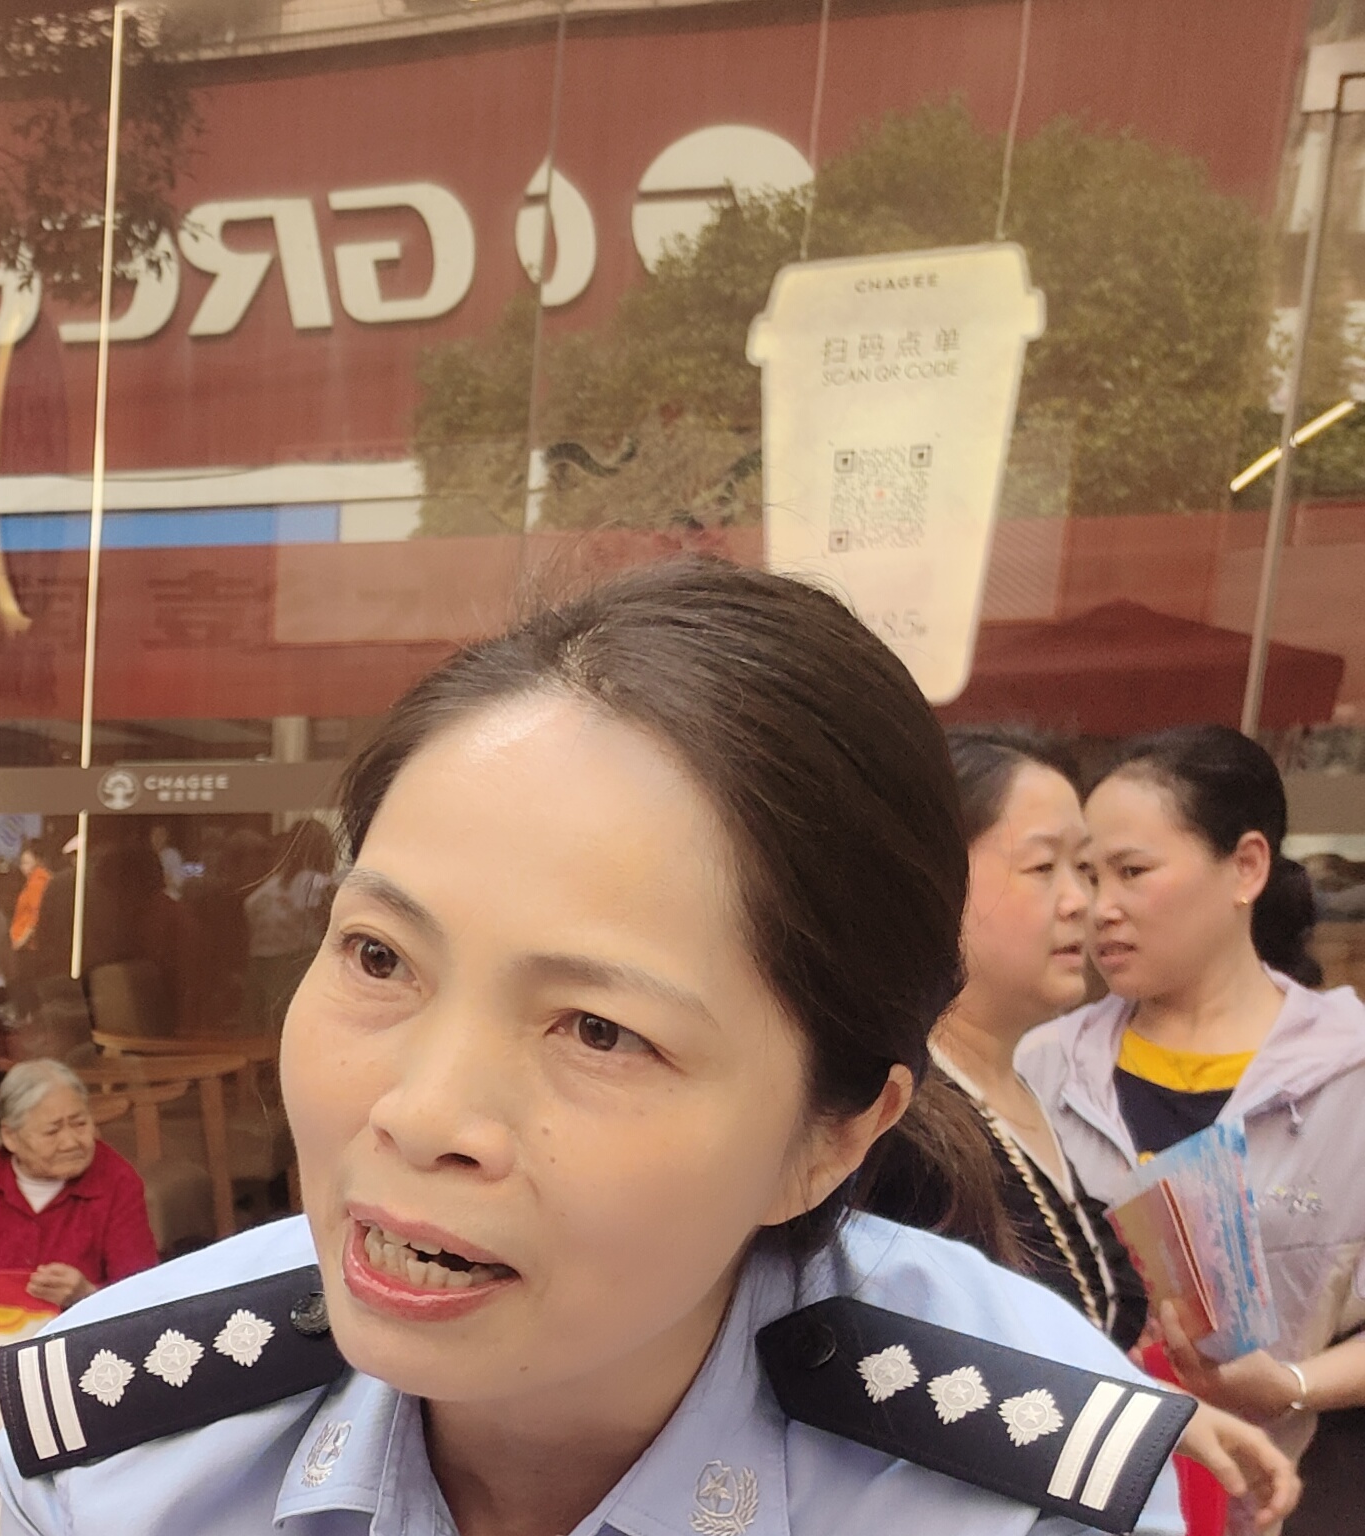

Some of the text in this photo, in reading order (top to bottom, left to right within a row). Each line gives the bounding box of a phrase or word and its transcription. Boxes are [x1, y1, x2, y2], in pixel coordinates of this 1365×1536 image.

[854, 273, 939, 293] CHAGEE
[822, 327, 960, 365] 扫码点单
[822, 367, 870, 386] SCAN
[904, 360, 959, 380] CODE
[144, 774, 229, 791] CHAGEE
